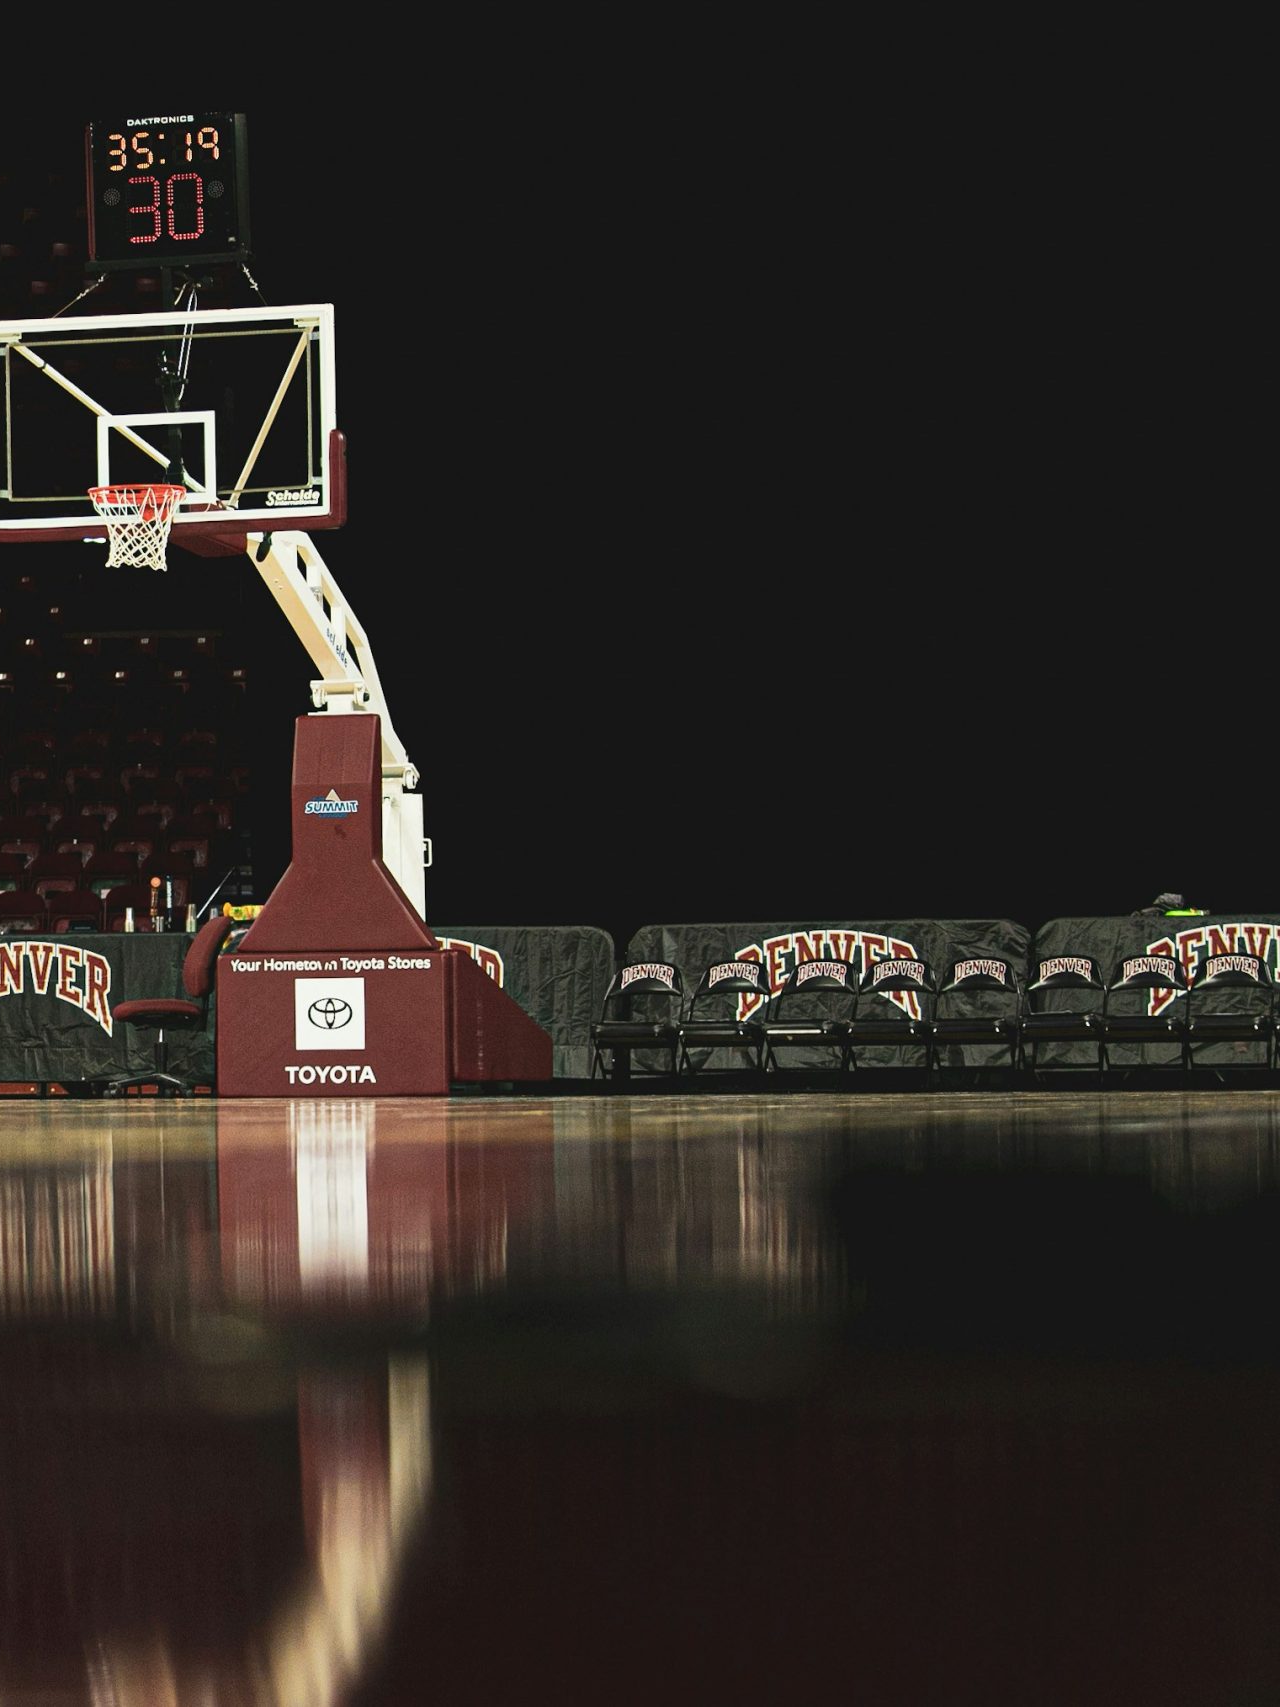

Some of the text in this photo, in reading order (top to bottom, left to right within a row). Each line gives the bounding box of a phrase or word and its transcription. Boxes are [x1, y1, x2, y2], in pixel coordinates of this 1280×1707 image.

[126, 114, 194, 127] DAKTRONICS
[108, 126, 220, 172] 35:19
[128, 172, 204, 244] 30
[304, 800, 359, 814] SUMMIT
[231, 959, 262, 972] Your
[340, 957, 385, 973] Toyota
[388, 956, 431, 970] Stores
[621, 964, 674, 989] DENVER
[709, 963, 759, 988] DENVER
[797, 962, 847, 986] DENVER
[873, 962, 924, 986] DENVER
[955, 960, 1006, 985] DENVER
[1040, 957, 1092, 982] DENVER
[1123, 958, 1176, 983] DENVER
[1146, 923, 1280, 1016] DENV
[1206, 957, 1259, 982] DENVER
[284, 1065, 377, 1085] TOYOTA
